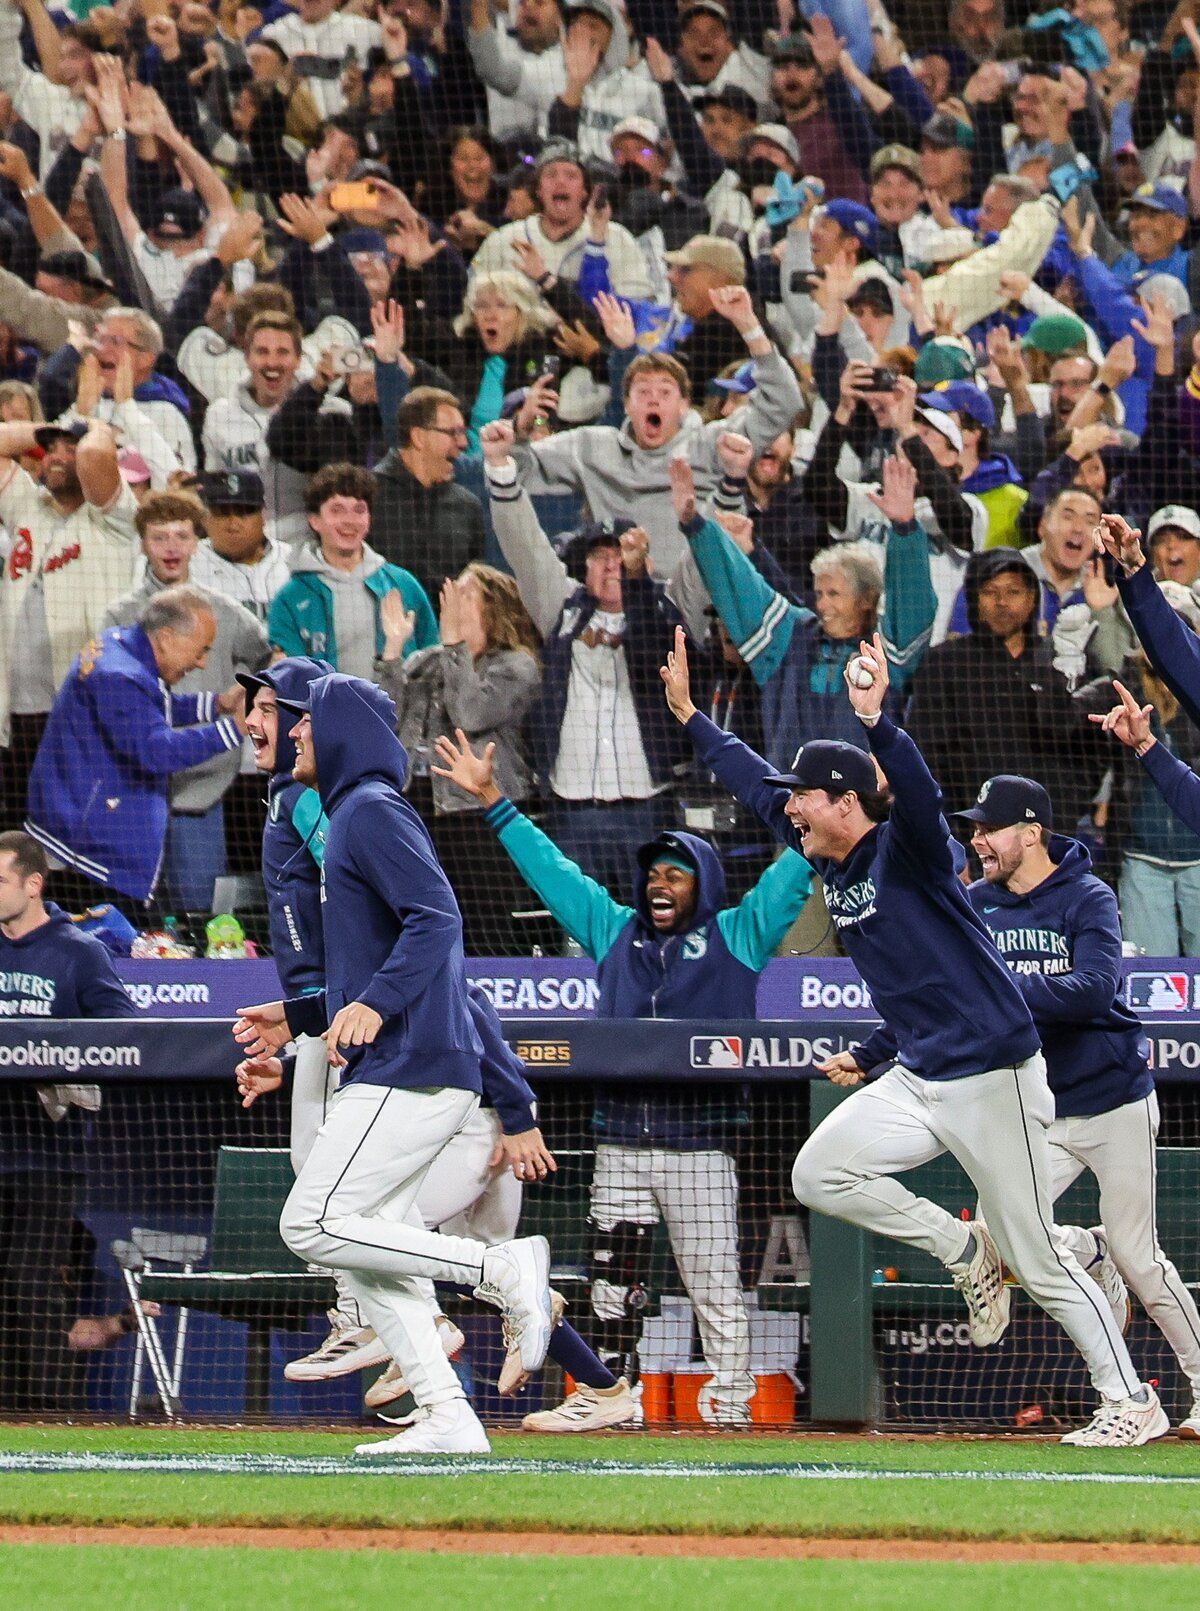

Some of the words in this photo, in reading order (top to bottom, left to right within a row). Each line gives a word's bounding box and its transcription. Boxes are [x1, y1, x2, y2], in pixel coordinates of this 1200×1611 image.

[283, 904, 303, 953] MARINERS
[990, 927, 1070, 958] ARINERS
[1016, 960, 1041, 976] FOR
[1043, 958, 1073, 975] FALL
[20, 999, 52, 1016] FALL
[121, 980, 210, 1010] ng.com
[466, 977, 601, 1011] SEASON
[517, 1045, 571, 1061] 2025
[745, 1037, 834, 1068] ALDS
